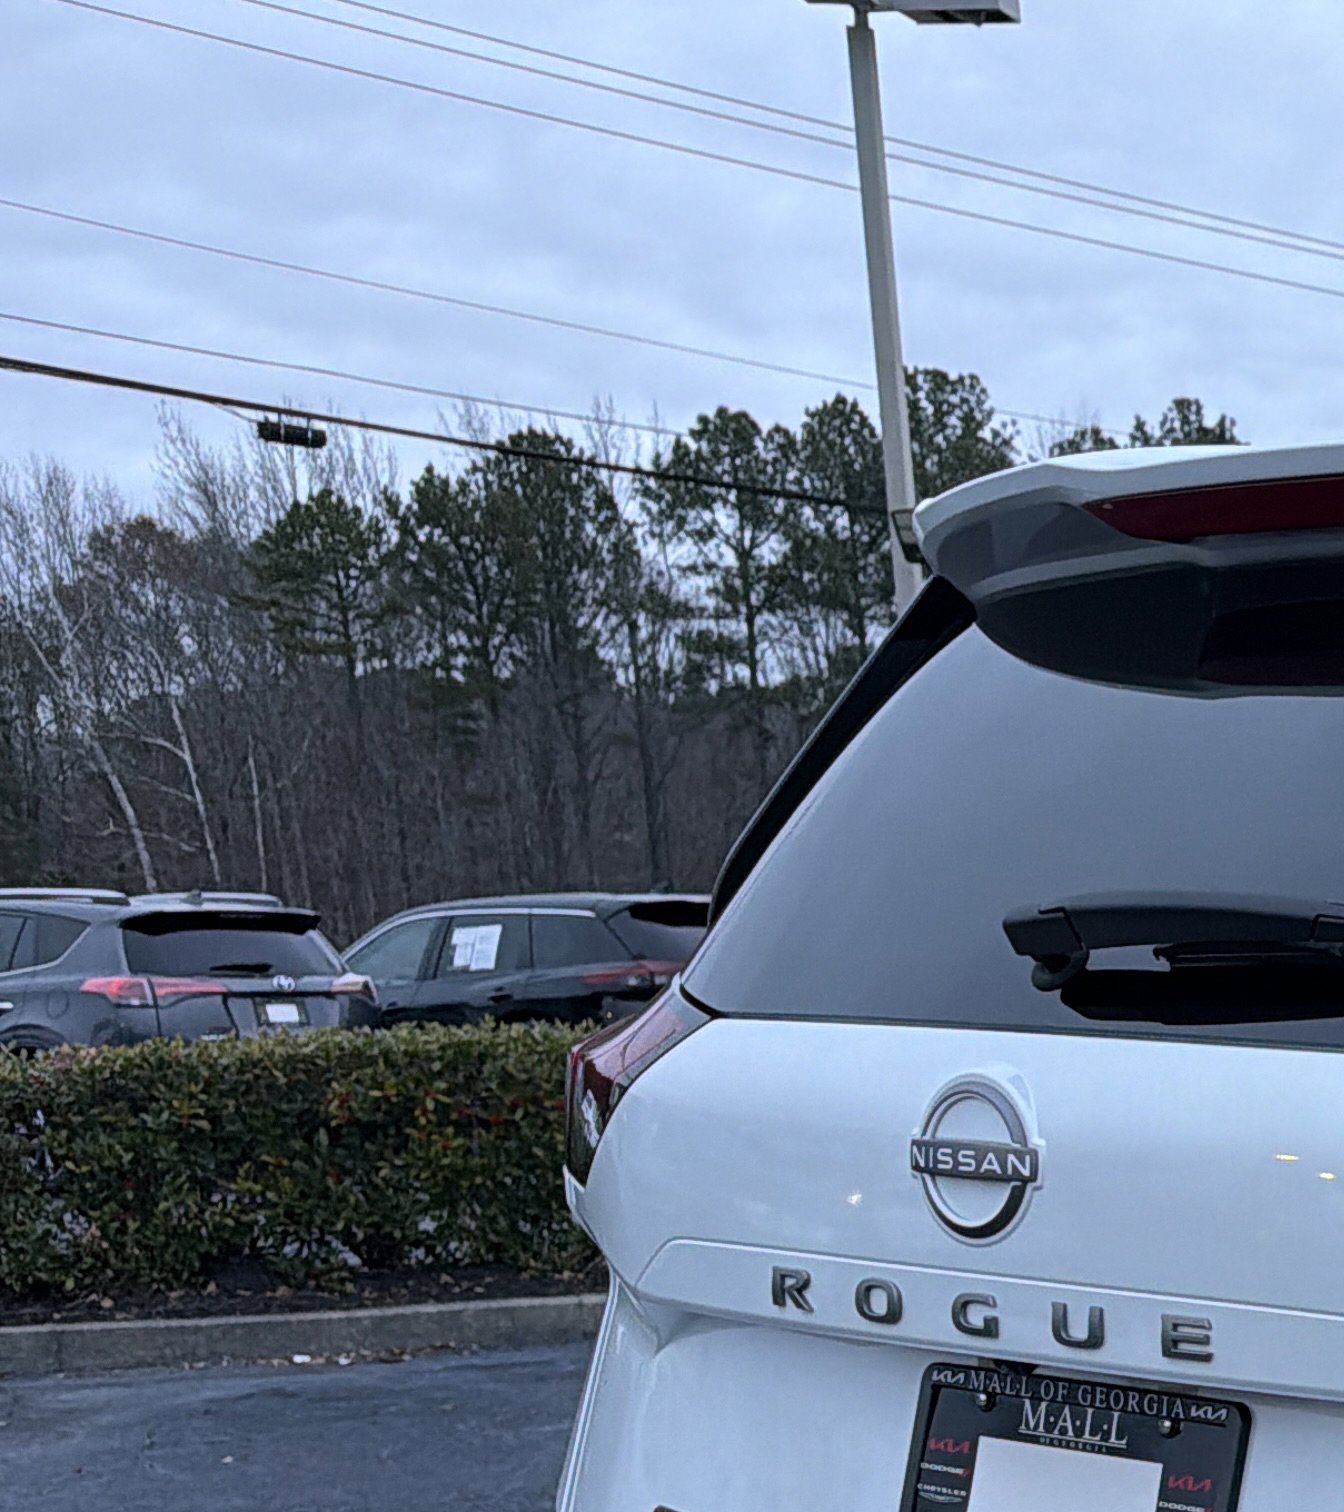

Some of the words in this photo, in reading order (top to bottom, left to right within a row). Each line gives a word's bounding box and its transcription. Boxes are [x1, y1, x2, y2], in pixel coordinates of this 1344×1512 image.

[912, 1145, 1032, 1178] NISSAN
[771, 1266, 1214, 1362] ROGUE
[1041, 1379, 1069, 1401] OF
[1077, 1385, 1185, 1419] GEORGIA
[920, 1462, 965, 1474] DODGE
[917, 1482, 967, 1497] CHRYSLER
